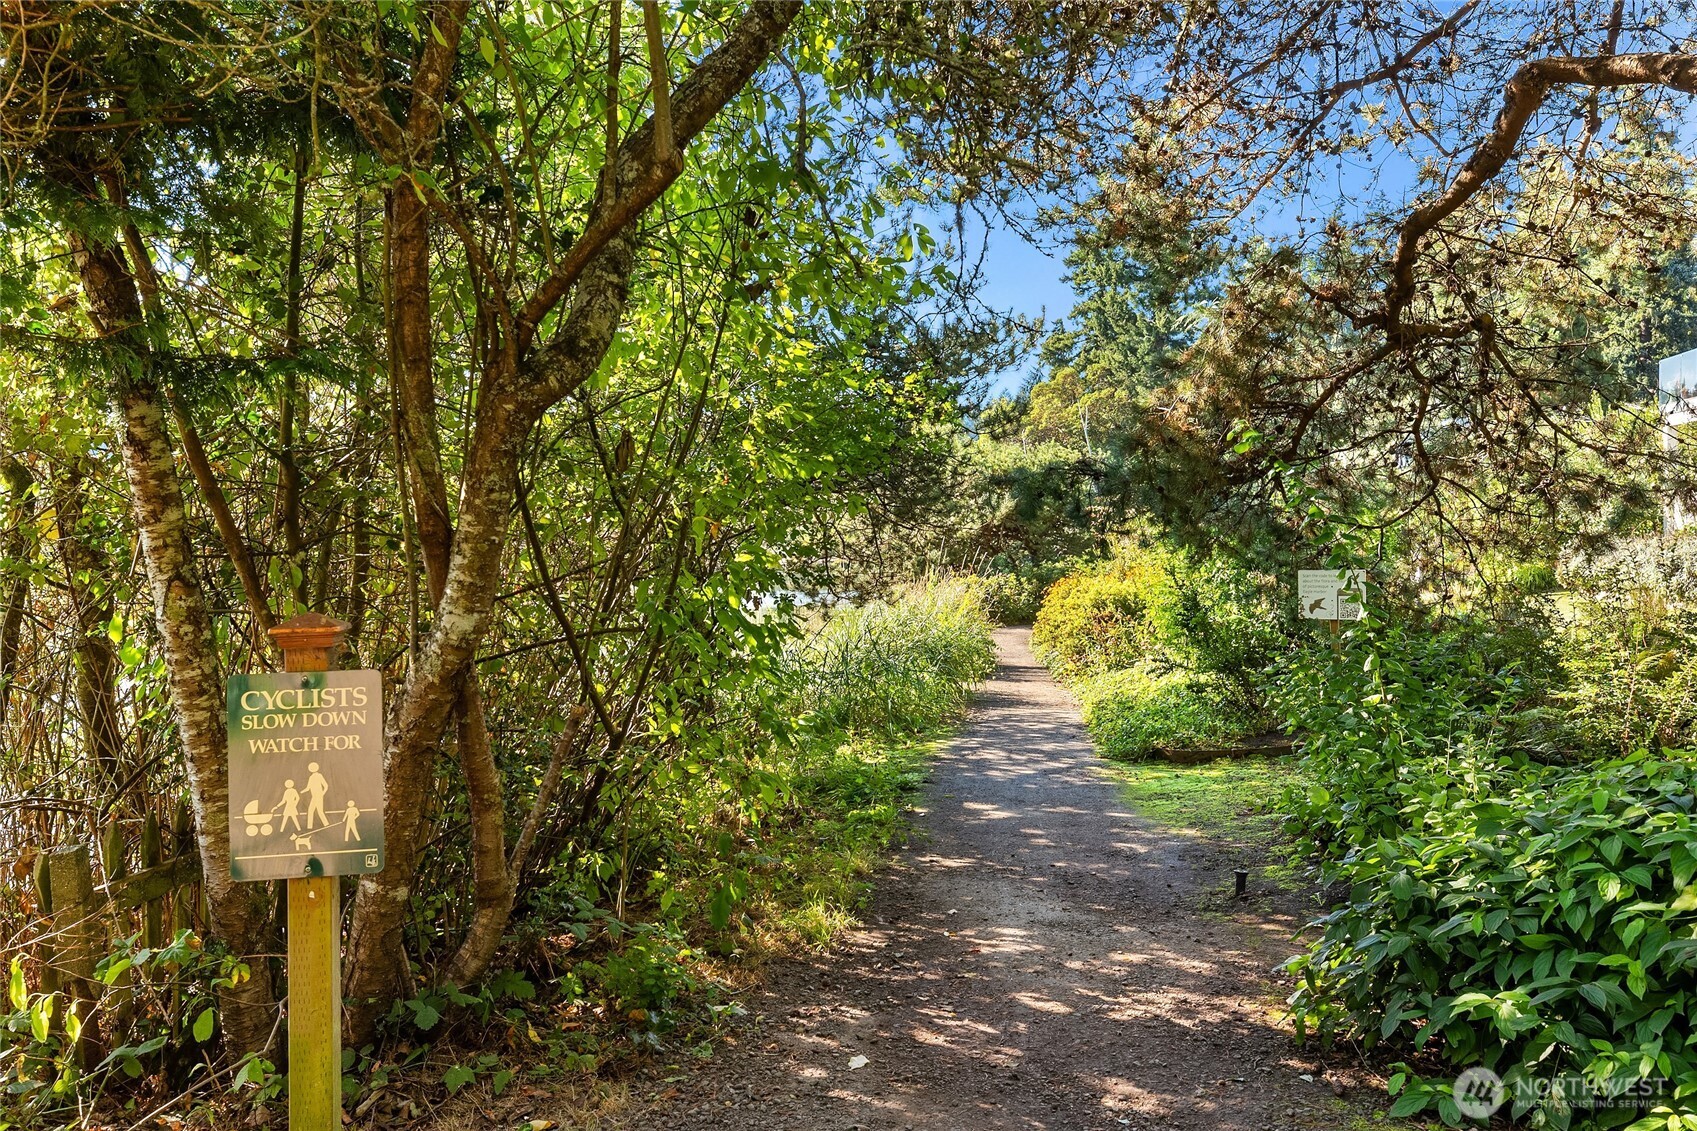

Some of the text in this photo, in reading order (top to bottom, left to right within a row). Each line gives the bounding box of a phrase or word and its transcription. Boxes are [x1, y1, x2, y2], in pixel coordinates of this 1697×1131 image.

[240, 687, 368, 711] CYCLISTS
[241, 711, 367, 730] SLOW DOWN
[248, 735, 362, 754] WATCH FOR
